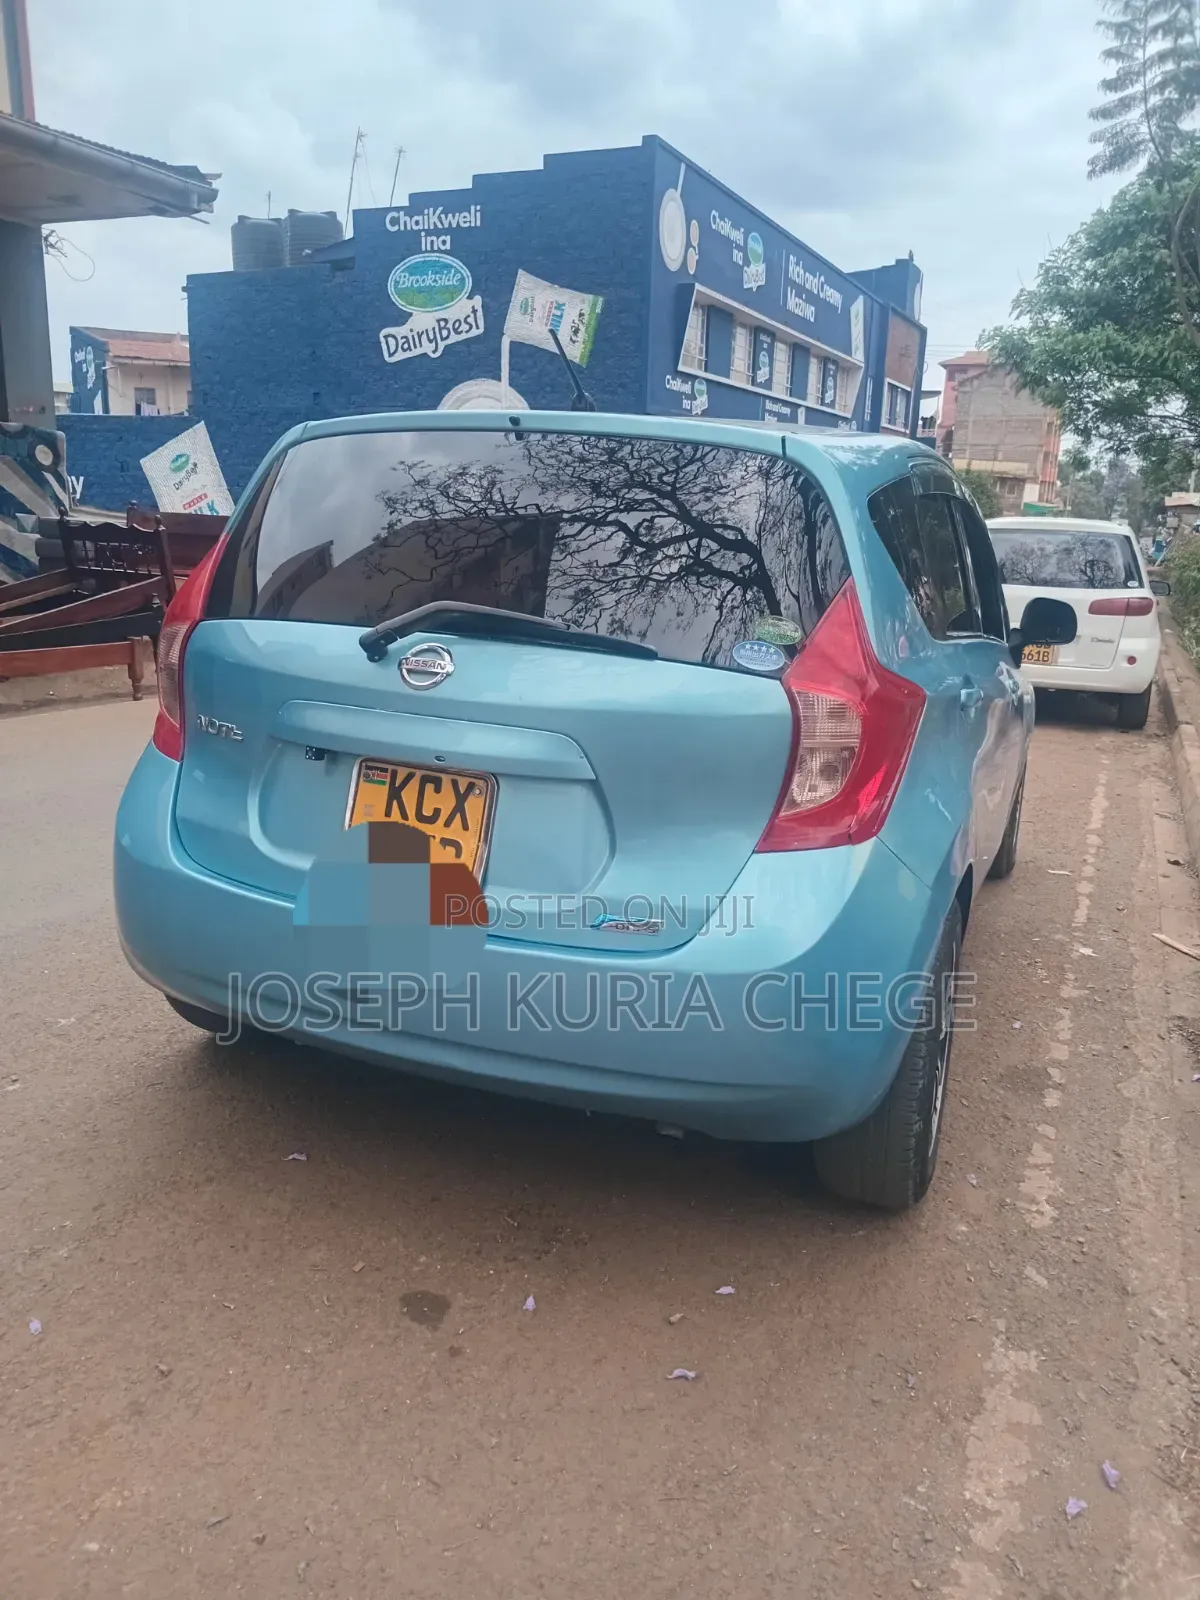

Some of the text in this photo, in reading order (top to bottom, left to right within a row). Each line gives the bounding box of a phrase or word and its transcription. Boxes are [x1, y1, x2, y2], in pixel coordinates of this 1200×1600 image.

[385, 205, 481, 232] ChaiKweli
[710, 209, 744, 246] ChaiKweli
[421, 231, 451, 251] ina
[732, 243, 743, 266] ina
[396, 268, 461, 288] Brookside
[788, 254, 843, 314] Rich and Creamy
[786, 286, 815, 323] Maziwa
[383, 304, 480, 358] DairyBest
[402, 658, 447, 671] NISSAN
[384, 769, 476, 832] KCX
